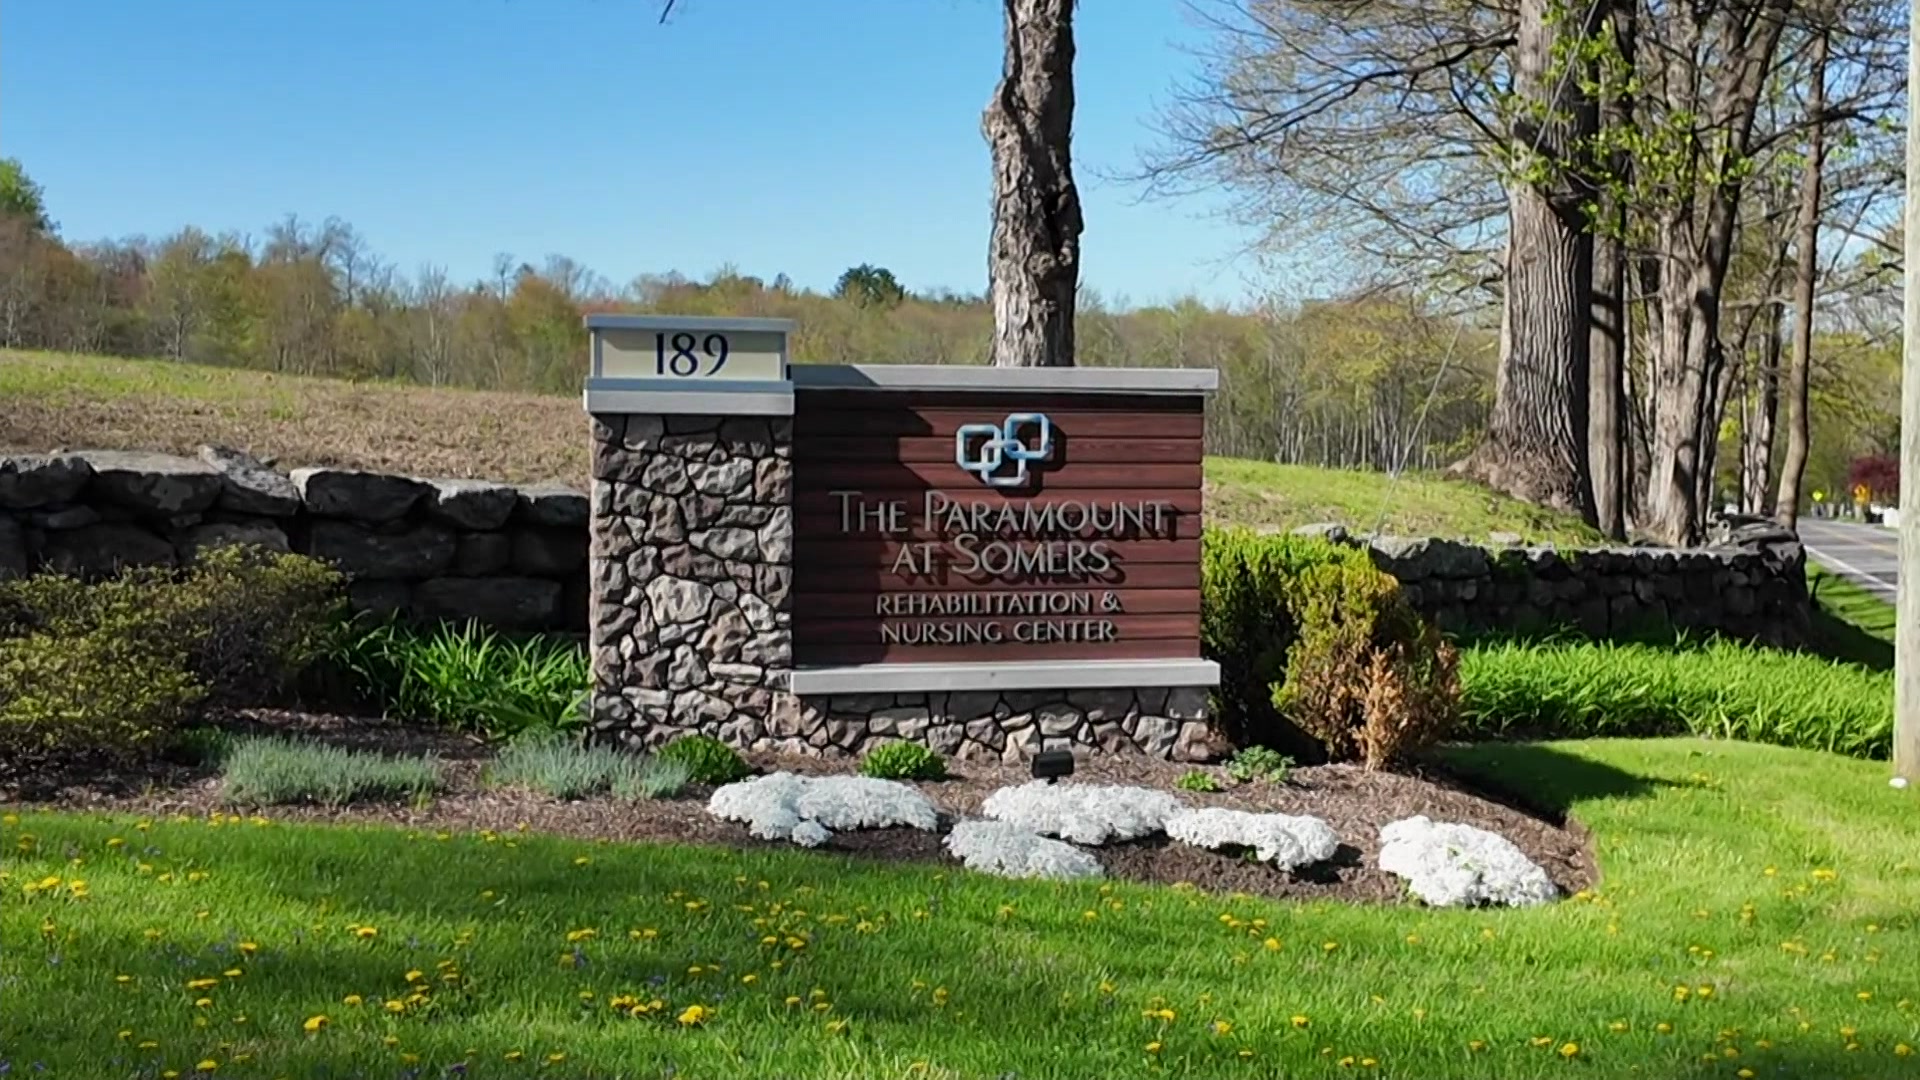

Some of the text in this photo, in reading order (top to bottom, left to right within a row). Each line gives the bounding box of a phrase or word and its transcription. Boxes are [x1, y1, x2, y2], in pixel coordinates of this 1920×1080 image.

[656, 332, 729, 377] 189
[828, 489, 1174, 533] THE PARAMOUNT
[891, 533, 1111, 575] AT SOMERS
[876, 590, 1121, 615] REHABILITATION &
[881, 620, 1115, 644] NURSING CENTER
